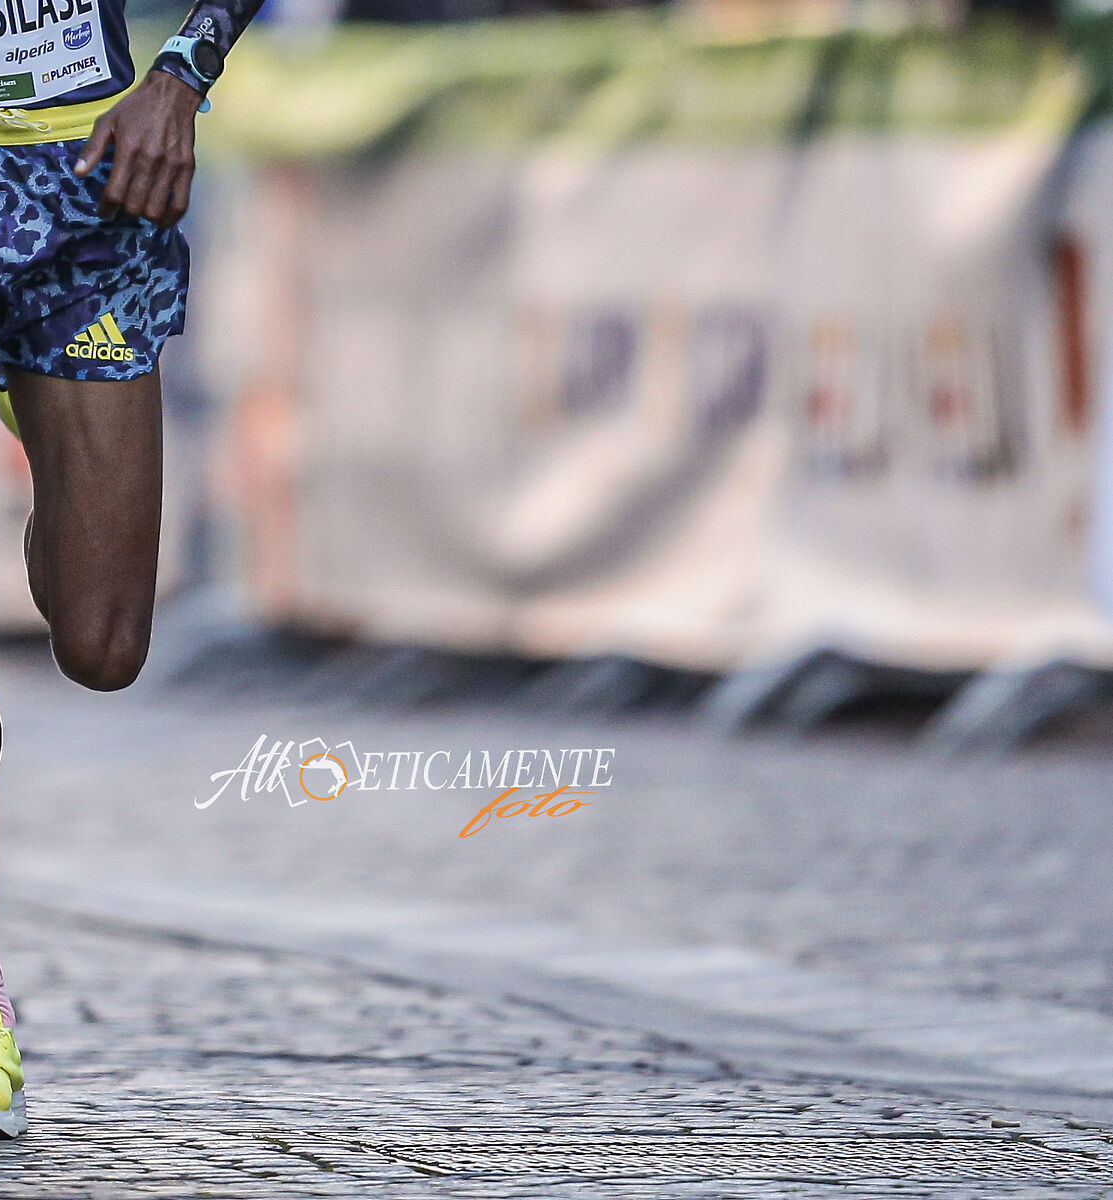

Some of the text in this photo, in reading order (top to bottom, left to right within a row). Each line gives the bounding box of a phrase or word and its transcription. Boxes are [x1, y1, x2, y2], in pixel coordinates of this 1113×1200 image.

[5, 39, 55, 64] alperia
[50, 56, 97, 81] PLATTNER
[65, 341, 135, 362] adidas
